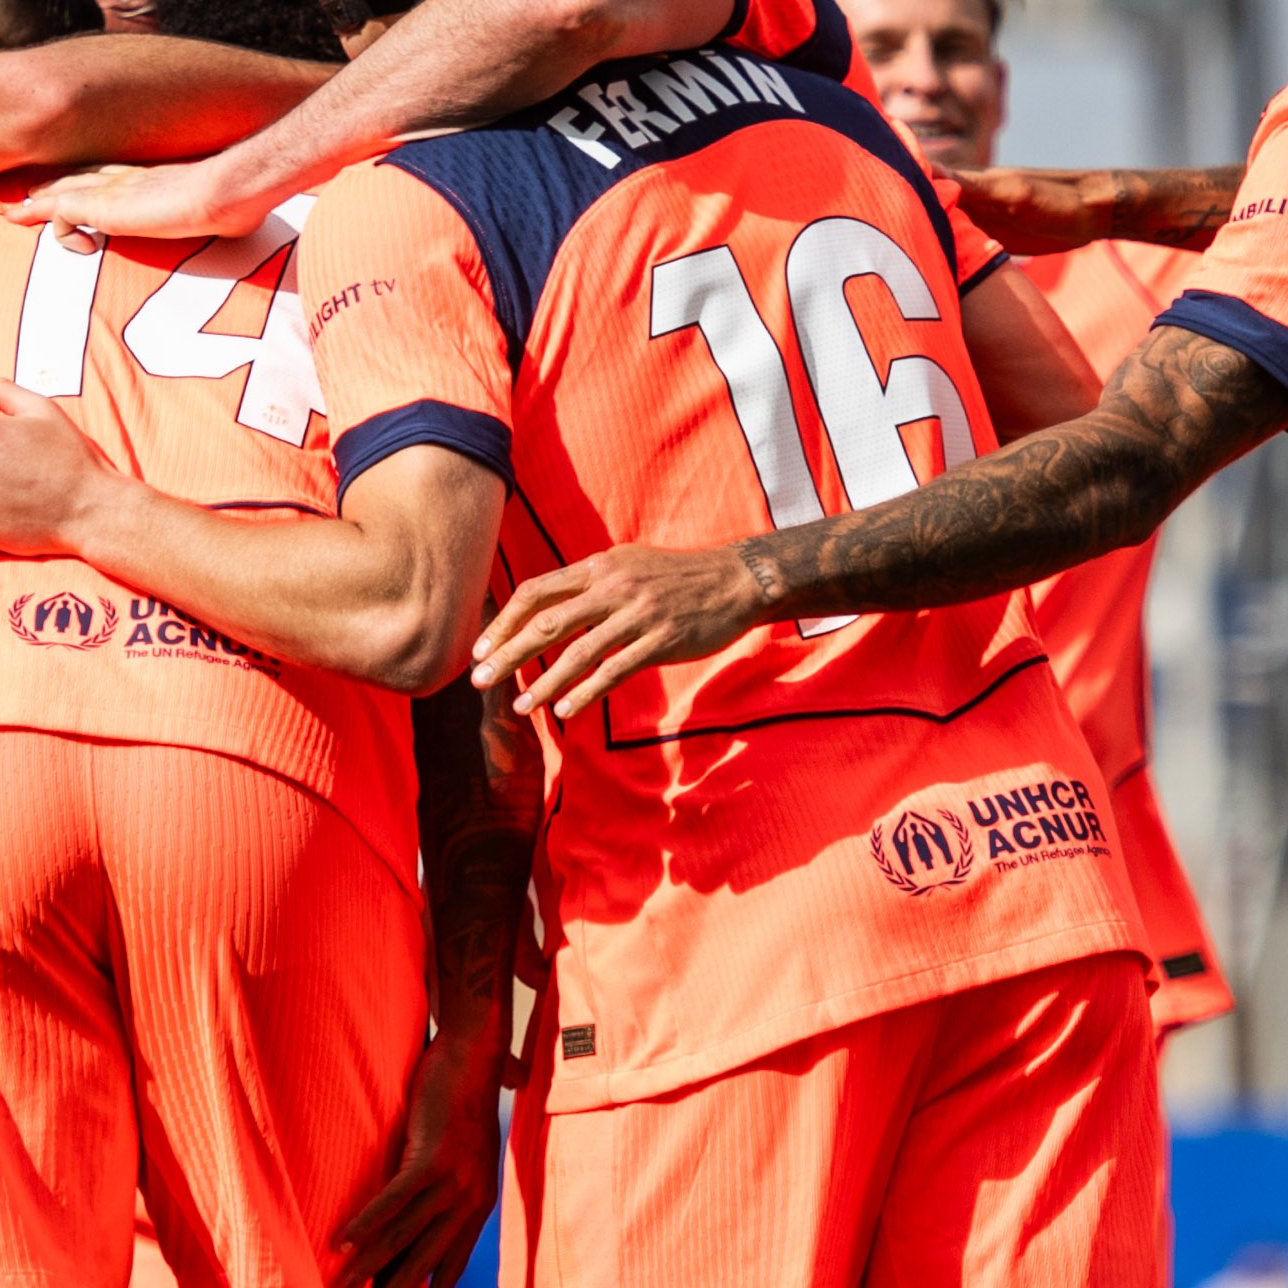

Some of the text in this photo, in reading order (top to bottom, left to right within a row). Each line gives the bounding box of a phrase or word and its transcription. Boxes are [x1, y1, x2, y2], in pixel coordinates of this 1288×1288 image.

[370, 278, 396, 296] tv
[14, 193, 327, 448] 14
[648, 215, 978, 640] 16
[124, 649, 149, 660] The
[152, 648, 173, 659] UN
[175, 649, 231, 667] Refugee
[967, 780, 1096, 828] UNHCR
[988, 811, 1107, 859] ACNUR
[995, 861, 1018, 874] The
[1020, 855, 1040, 868] UN
[1041, 846, 1085, 863] Refugee
